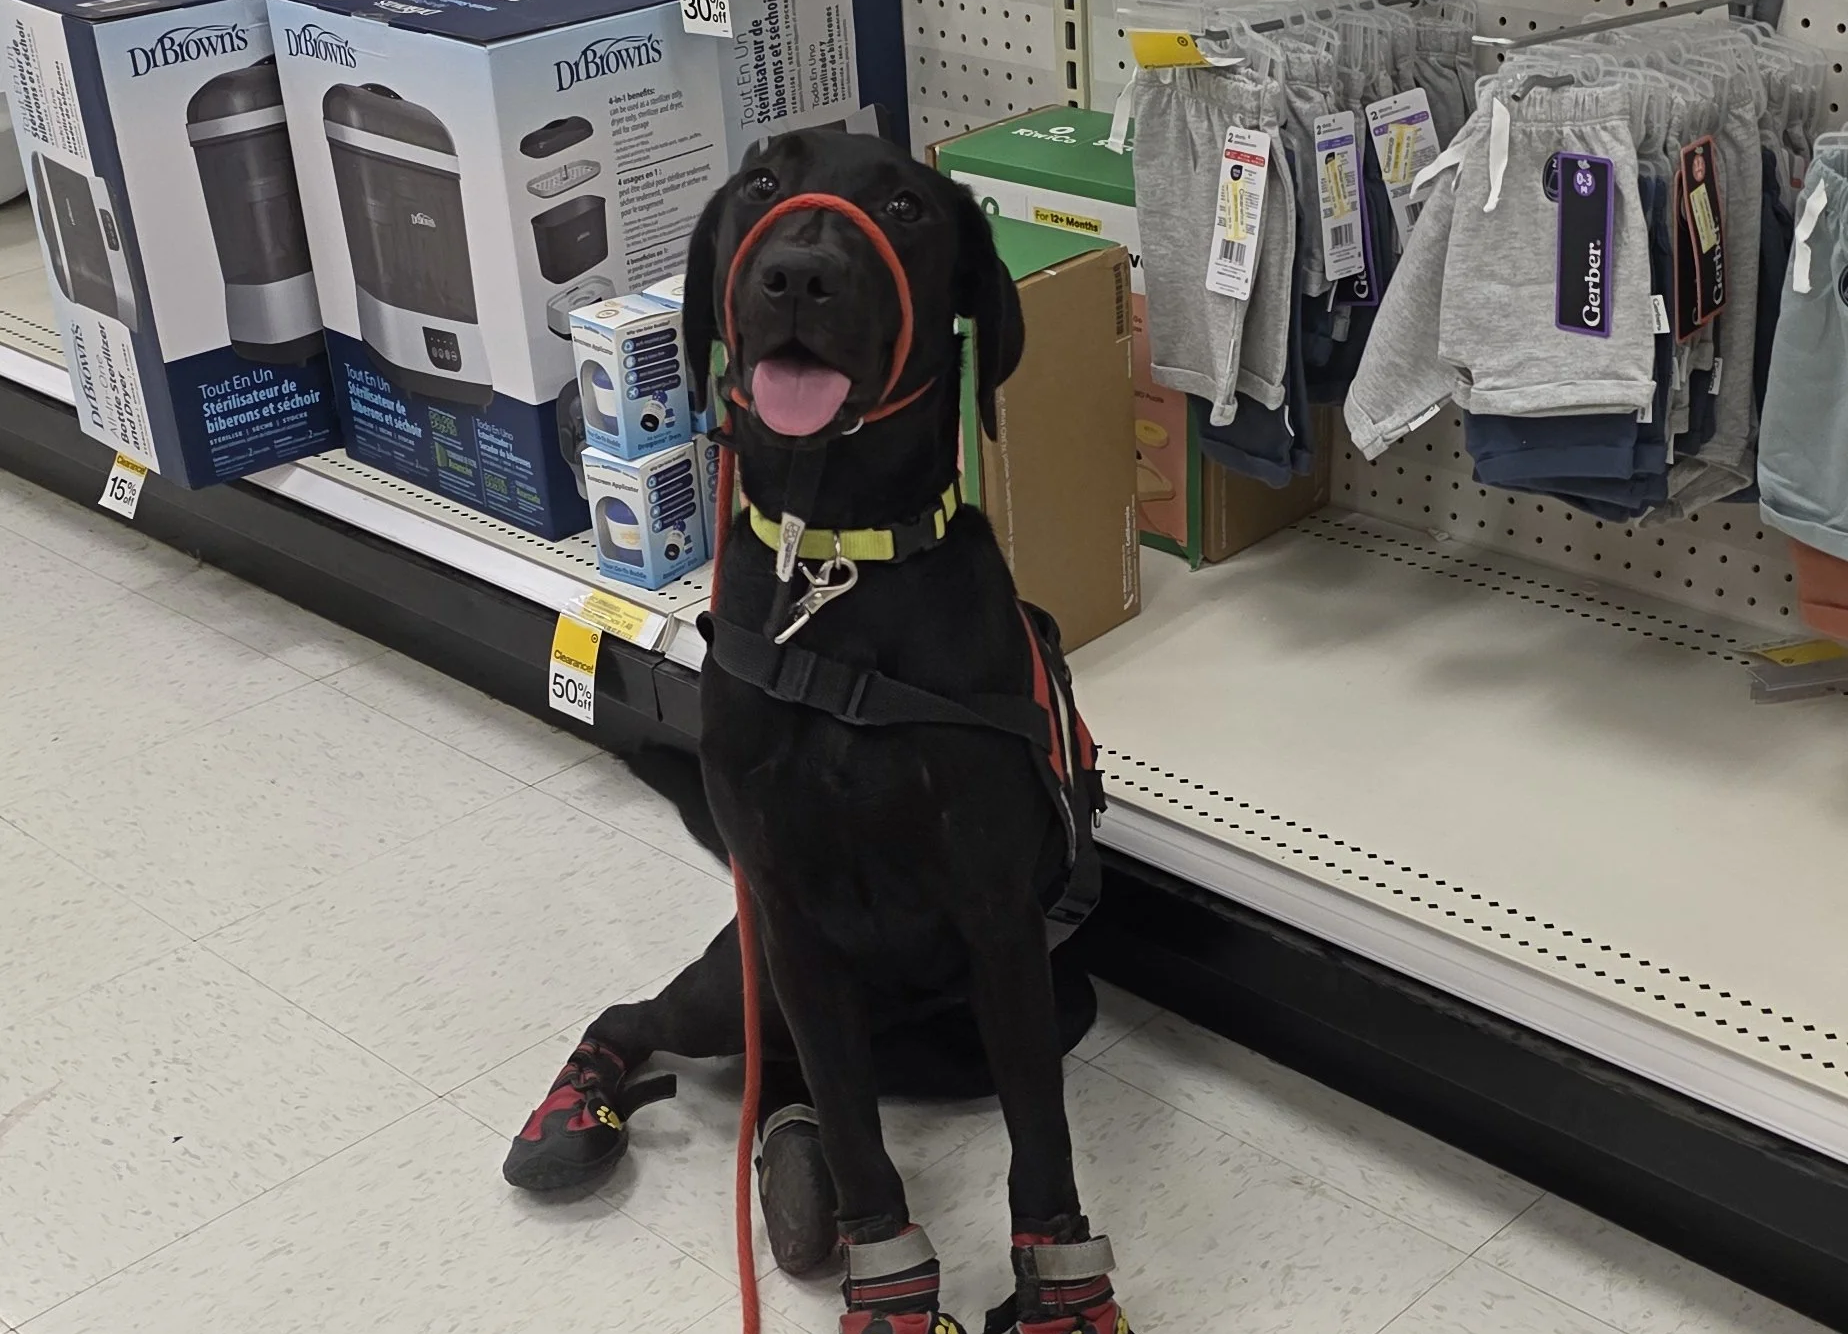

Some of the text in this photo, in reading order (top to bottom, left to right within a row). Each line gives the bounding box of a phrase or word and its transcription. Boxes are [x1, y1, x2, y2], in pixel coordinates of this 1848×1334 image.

[713, 11, 726, 24] off
[825, 6, 834, 51] biberones
[12, 39, 23, 55] de
[769, 42, 782, 58] et
[829, 53, 836, 62] de
[27, 69, 35, 84] et
[734, 33, 754, 130] Tout En Un
[748, 19, 770, 124] Stérilisateur de
[808, 44, 819, 109] Todo En Uno
[608, 87, 655, 105] 4-in-1 benefits:
[772, 60, 788, 120] biberons
[1370, 111, 1378, 121] 2
[1012, 128, 1077, 144] KiwiCo
[1227, 133, 1234, 143] 2
[1316, 124, 1322, 135] 2
[1035, 210, 1098, 232] For 12+ Months
[1582, 242, 1601, 327] Gerber
[97, 321, 130, 445] Bottle Sterilizer
[198, 369, 274, 399] Tout En Un
[344, 363, 391, 394] Tout En Un
[203, 379, 297, 417] Stérilisateur de
[395, 401, 407, 417] de
[118, 370, 141, 451] and Dryer
[206, 390, 321, 434] biberons et séchoir
[123, 494, 134, 507] off
[554, 649, 593, 674] Clearance!
[578, 699, 591, 711] off
